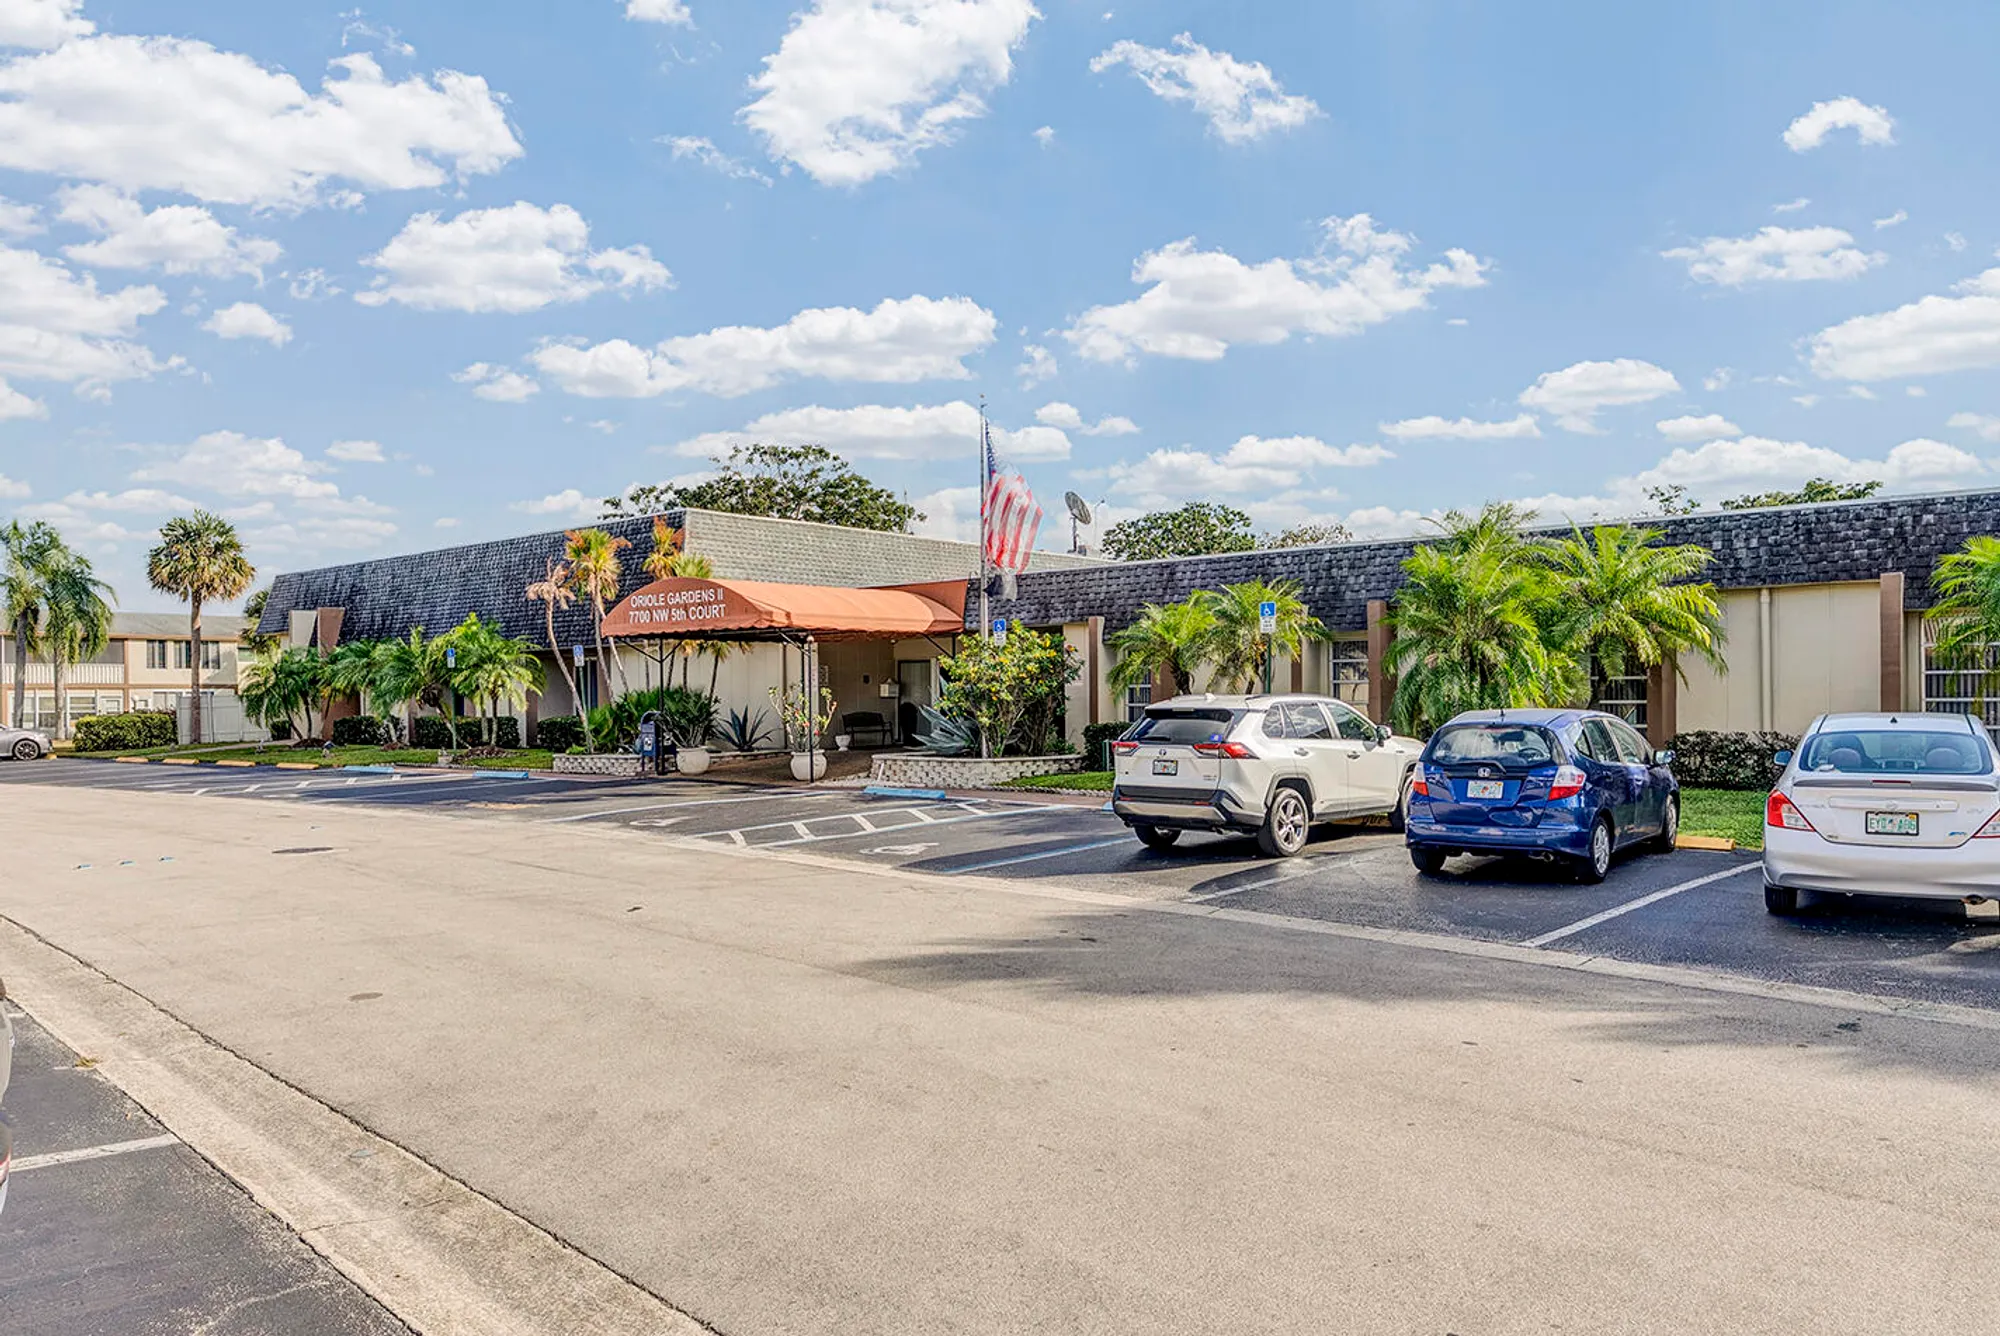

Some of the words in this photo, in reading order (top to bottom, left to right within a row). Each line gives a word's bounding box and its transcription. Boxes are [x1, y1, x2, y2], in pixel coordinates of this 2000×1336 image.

[630, 592, 665, 608] ORIOLE
[667, 588, 715, 605] GARDENS
[717, 587, 724, 601] II
[629, 610, 651, 624] 7700
[652, 608, 670, 622] NW
[671, 607, 687, 621] 5th
[689, 603, 726, 620] COURT
